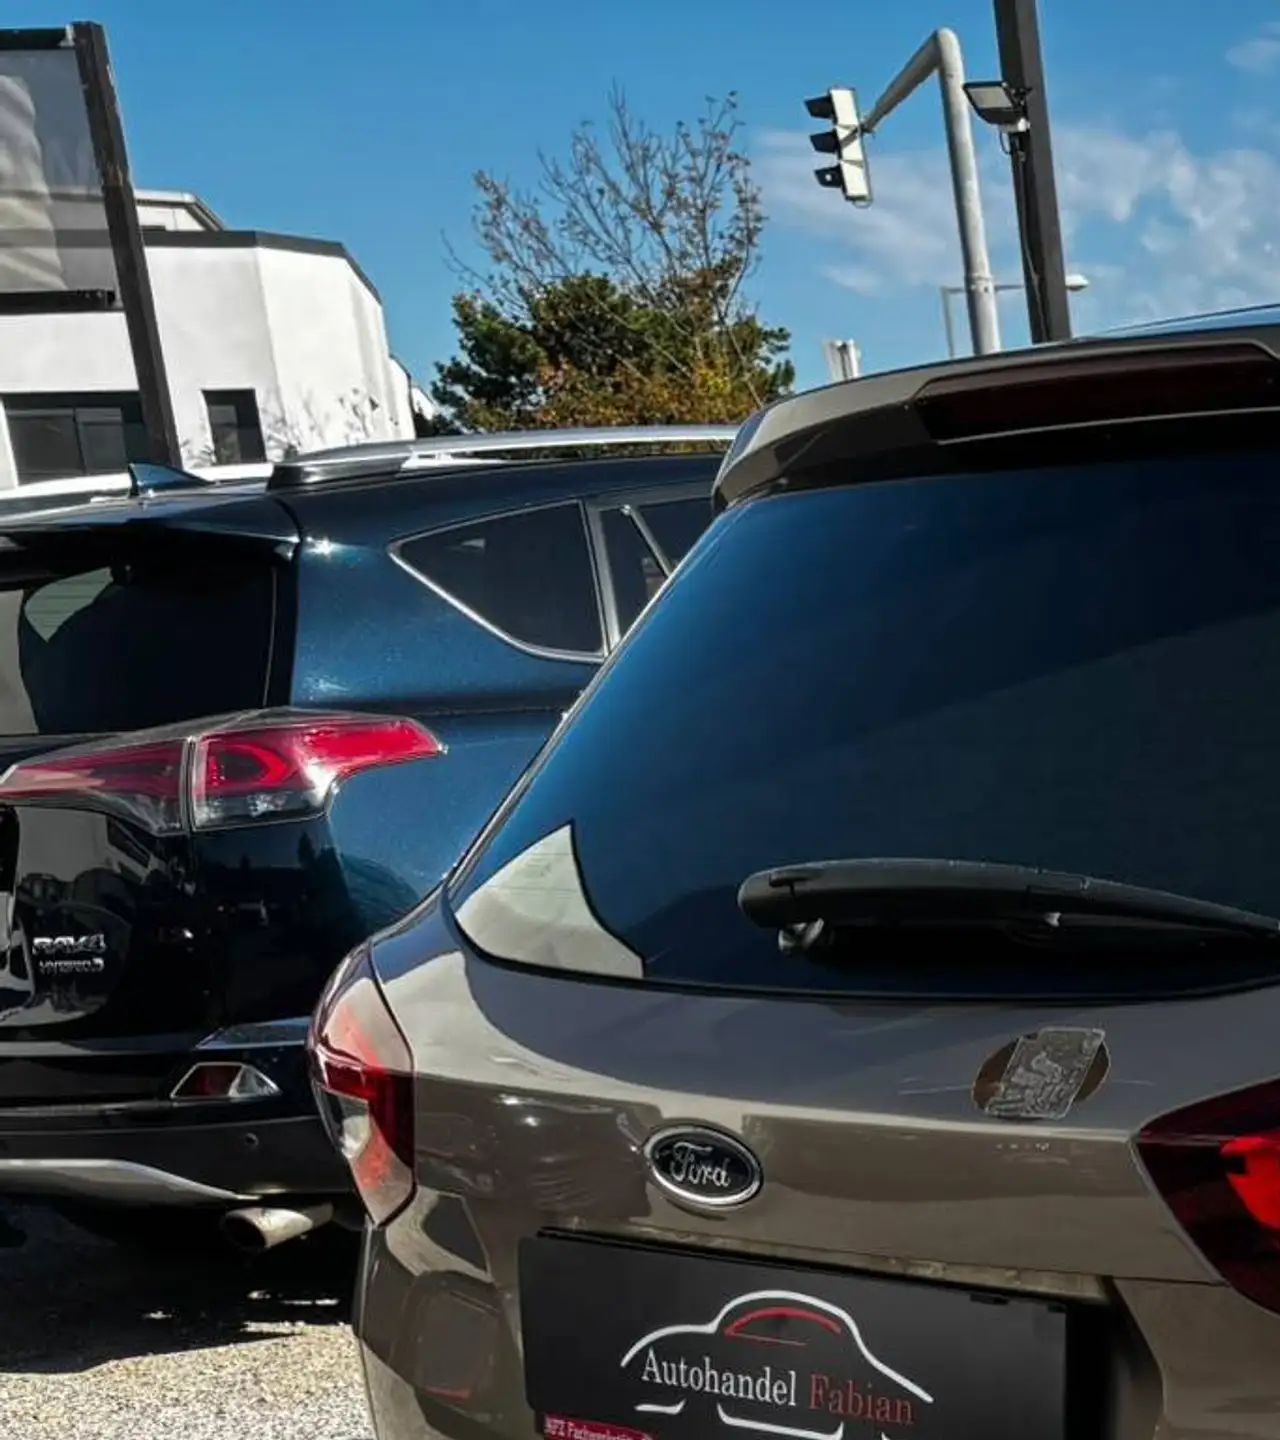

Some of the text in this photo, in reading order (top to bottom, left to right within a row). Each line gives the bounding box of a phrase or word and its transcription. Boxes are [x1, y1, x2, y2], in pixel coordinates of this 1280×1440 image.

[670, 1141, 732, 1187] Ford
[641, 1346, 915, 1426] Autohandel Fabian
